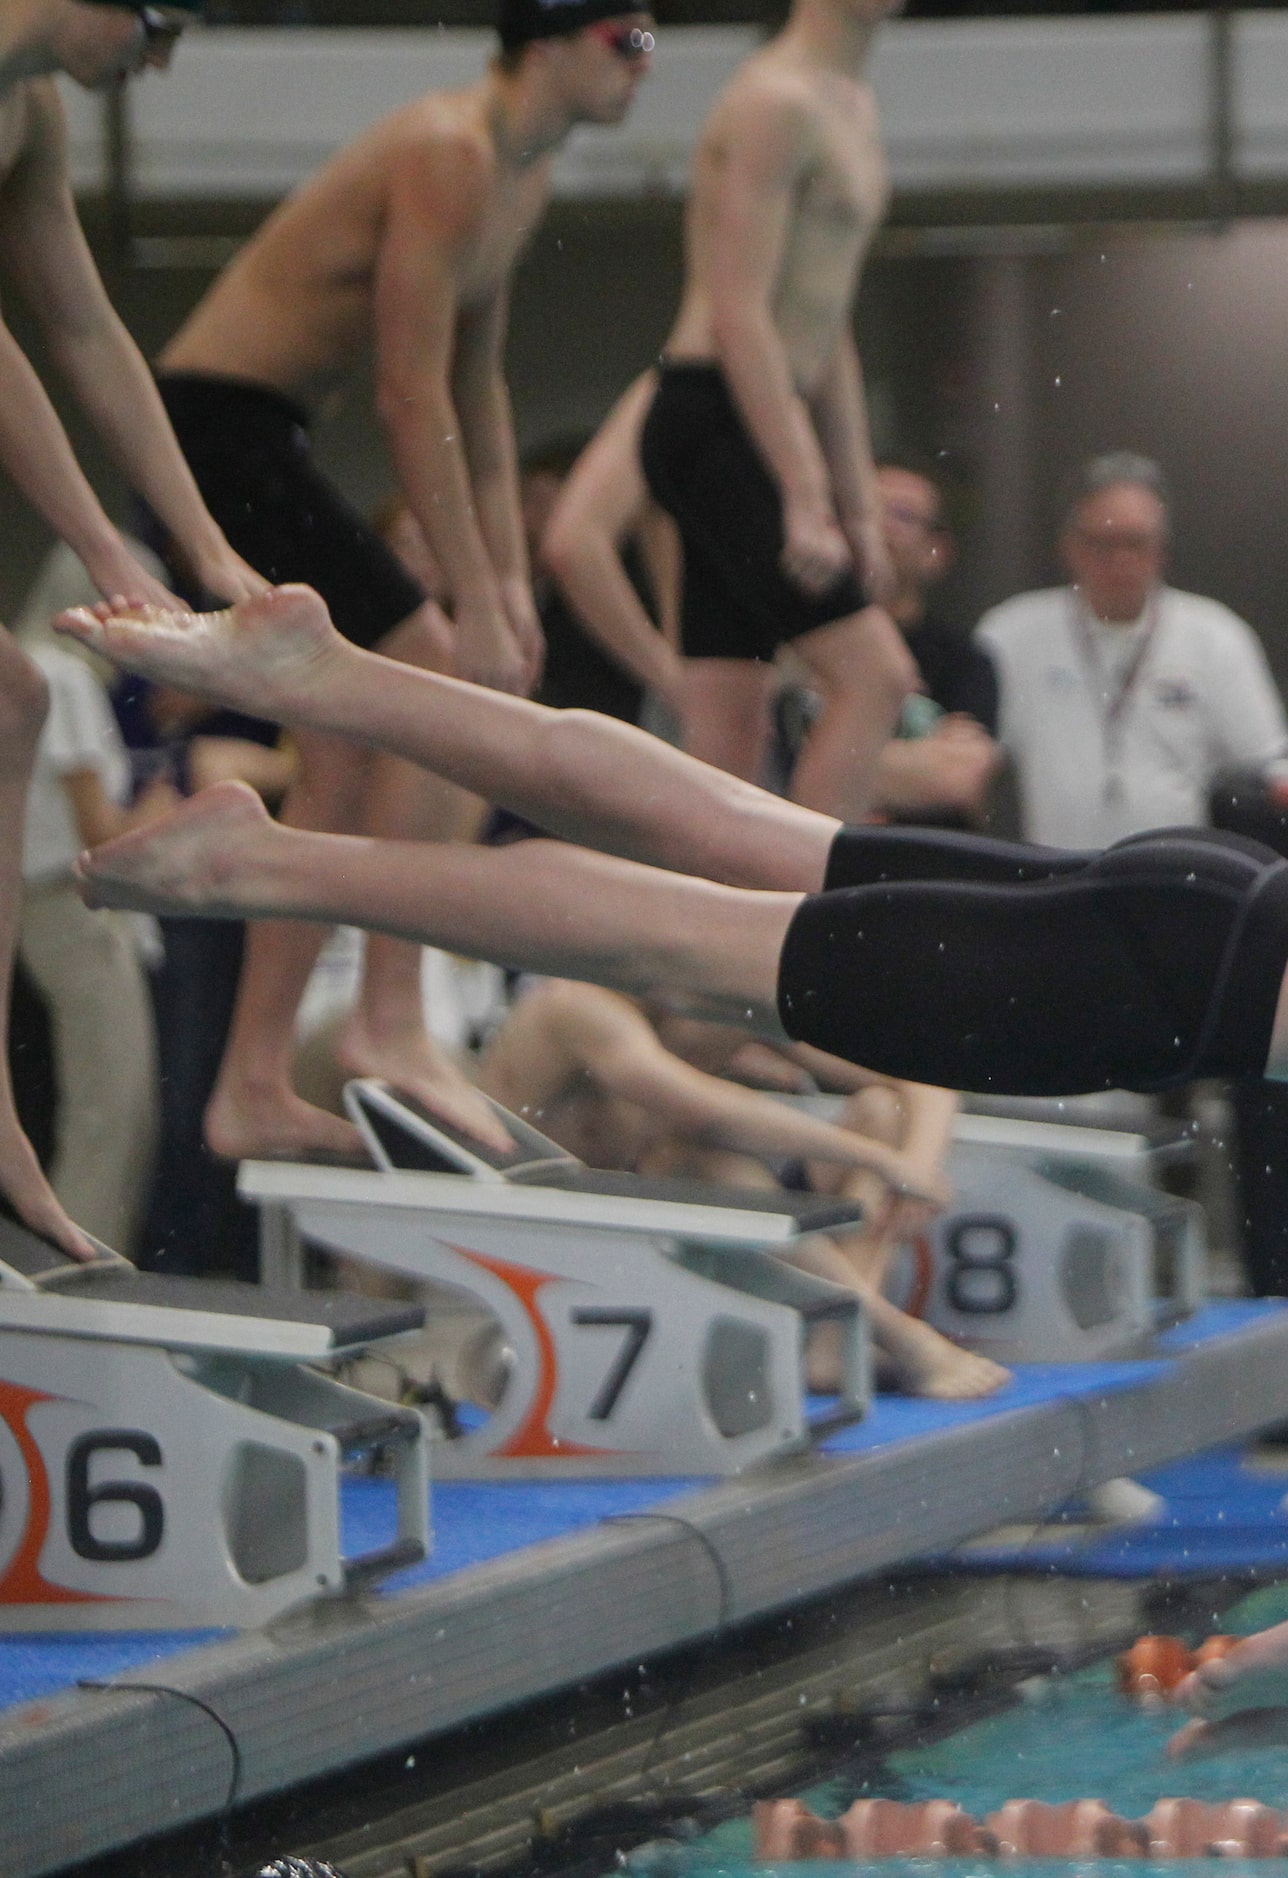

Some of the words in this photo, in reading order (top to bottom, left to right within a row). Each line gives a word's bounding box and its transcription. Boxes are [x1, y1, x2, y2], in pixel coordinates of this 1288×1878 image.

[946, 1215, 1018, 1314] 8
[571, 1307, 652, 1420] 7
[66, 1429, 164, 1561] 6
